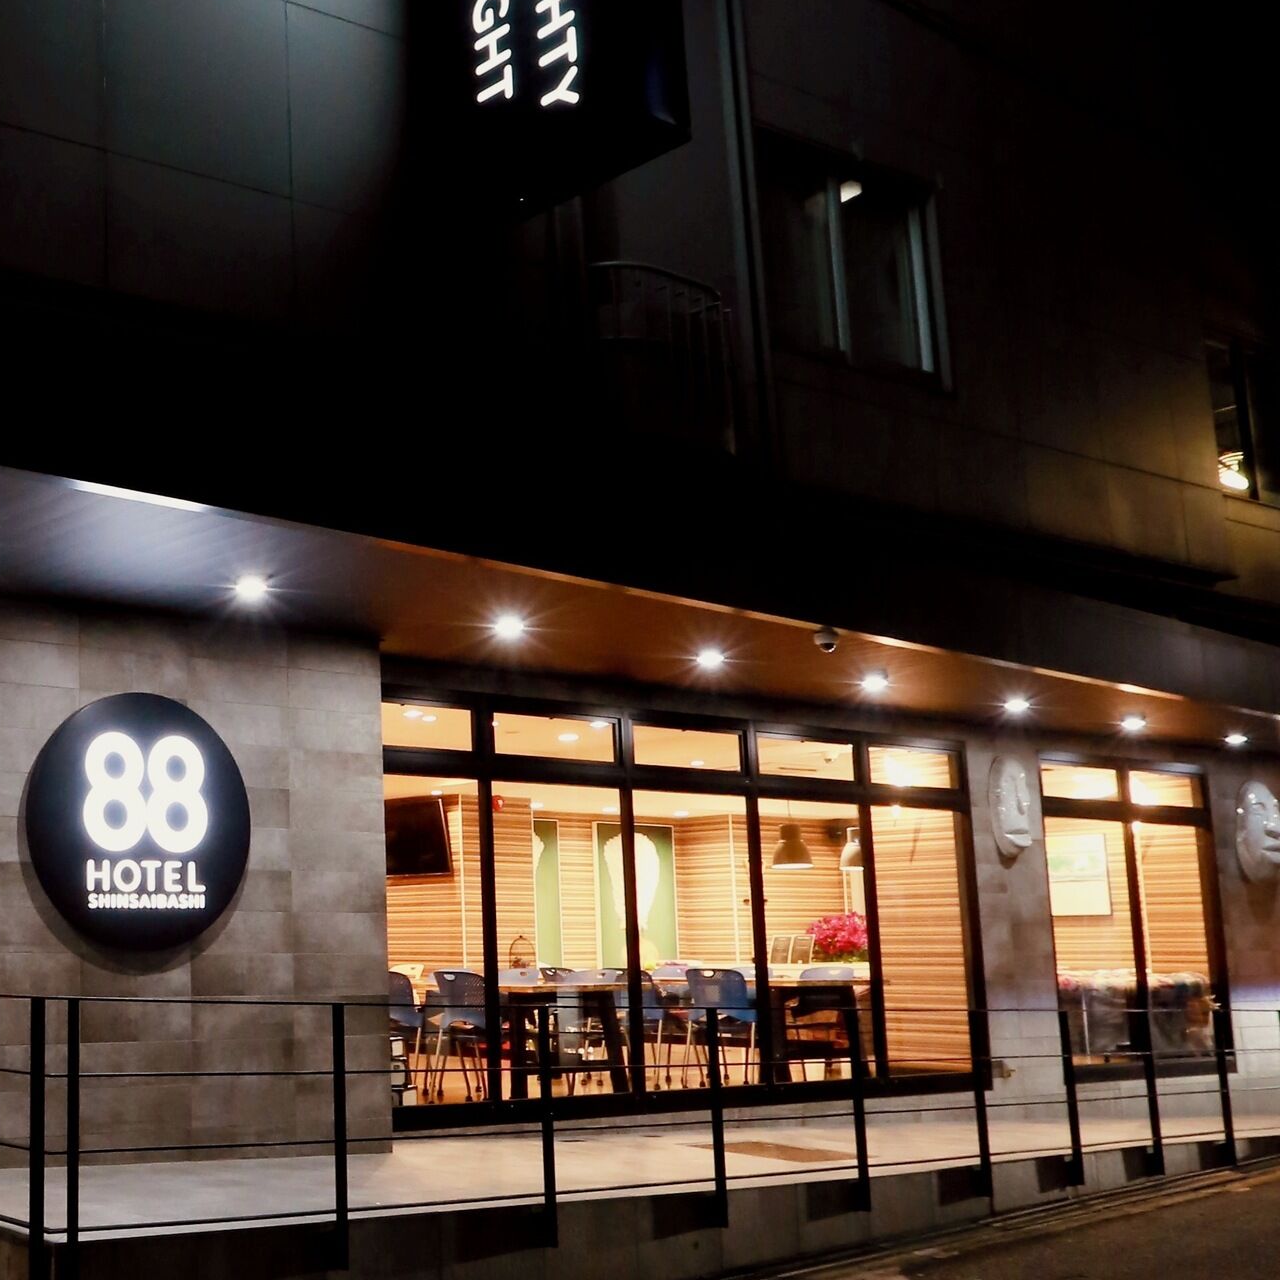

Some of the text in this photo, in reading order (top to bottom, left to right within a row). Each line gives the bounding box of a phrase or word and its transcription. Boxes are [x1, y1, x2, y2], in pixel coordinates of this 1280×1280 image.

[82, 731, 209, 853] 88
[85, 858, 207, 893] HOTEL
[87, 893, 206, 910] SHINSAIBASHI
